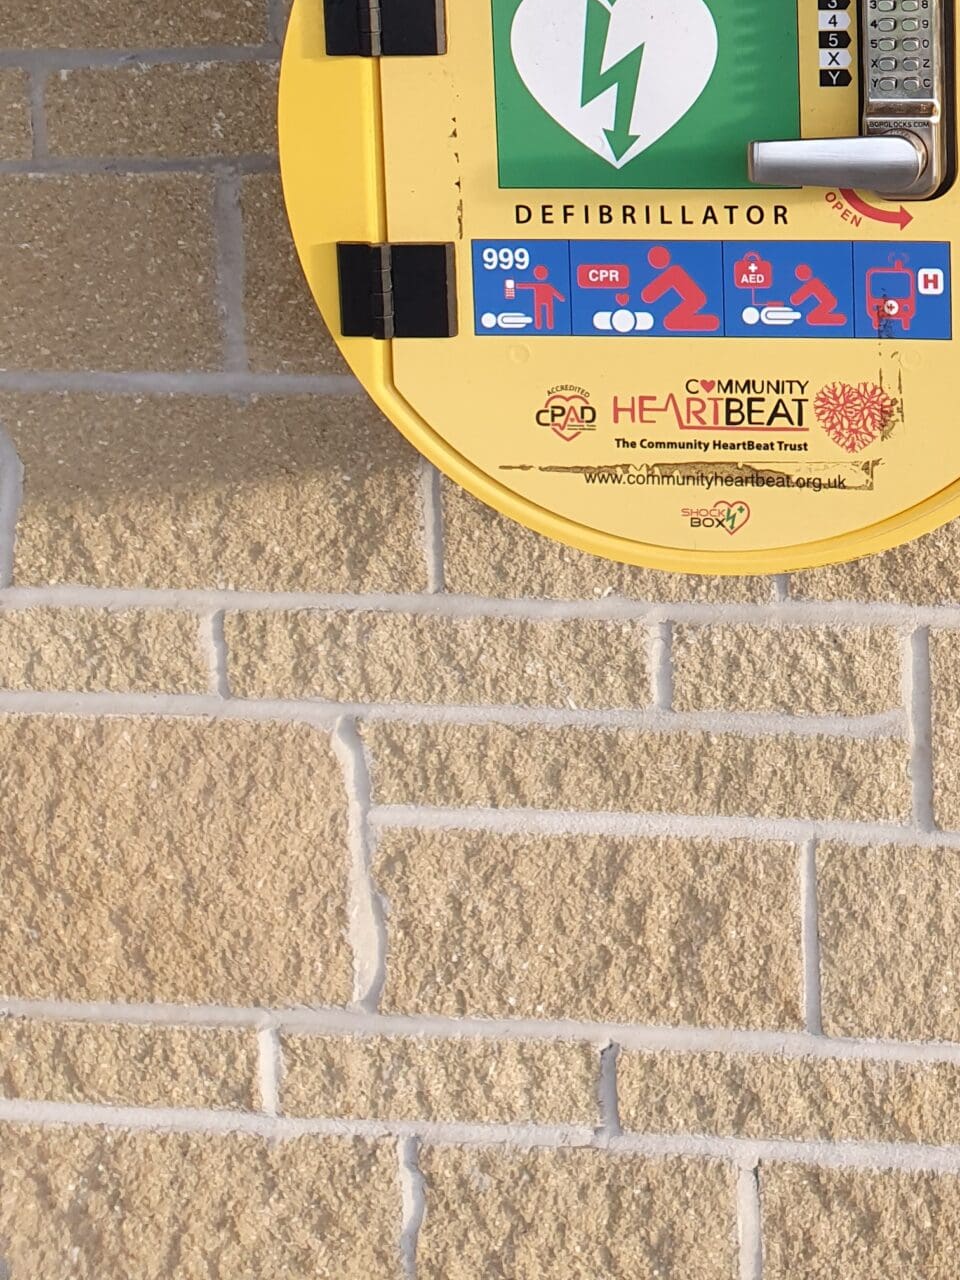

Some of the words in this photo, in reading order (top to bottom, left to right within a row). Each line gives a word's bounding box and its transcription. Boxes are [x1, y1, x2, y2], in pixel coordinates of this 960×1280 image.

[869, 0, 877, 10] 3
[921, 0, 929, 9] 8
[827, 14, 839, 28] 4
[870, 19, 878, 29] 4
[921, 19, 929, 29] 9
[828, 34, 839, 47] 5
[870, 39, 878, 49] 5
[922, 39, 930, 49] 0
[827, 52, 841, 66] X
[871, 59, 879, 69] X
[922, 58, 931, 69] Z
[828, 71, 841, 85] Y
[871, 78, 879, 88] Y
[922, 78, 931, 88] C
[514, 204, 790, 225] DEFIBRILLATOR
[825, 191, 862, 227] OPEN
[482, 247, 531, 271] 999
[587, 268, 620, 283] CPR
[740, 272, 765, 285] AED
[923, 274, 939, 290] H
[546, 384, 590, 398] ACCREDITED
[535, 405, 597, 428] CPAD
[613, 393, 810, 429] HEARTBEAT
[614, 438, 637, 449] The
[639, 438, 710, 452] Community
[712, 439, 775, 451] HeartBeat
[777, 440, 809, 451] Trust
[584, 472, 847, 492] www.communityheartbeat.org.uk
[680, 507, 726, 518] SHOCK
[690, 517, 727, 528] BOX
